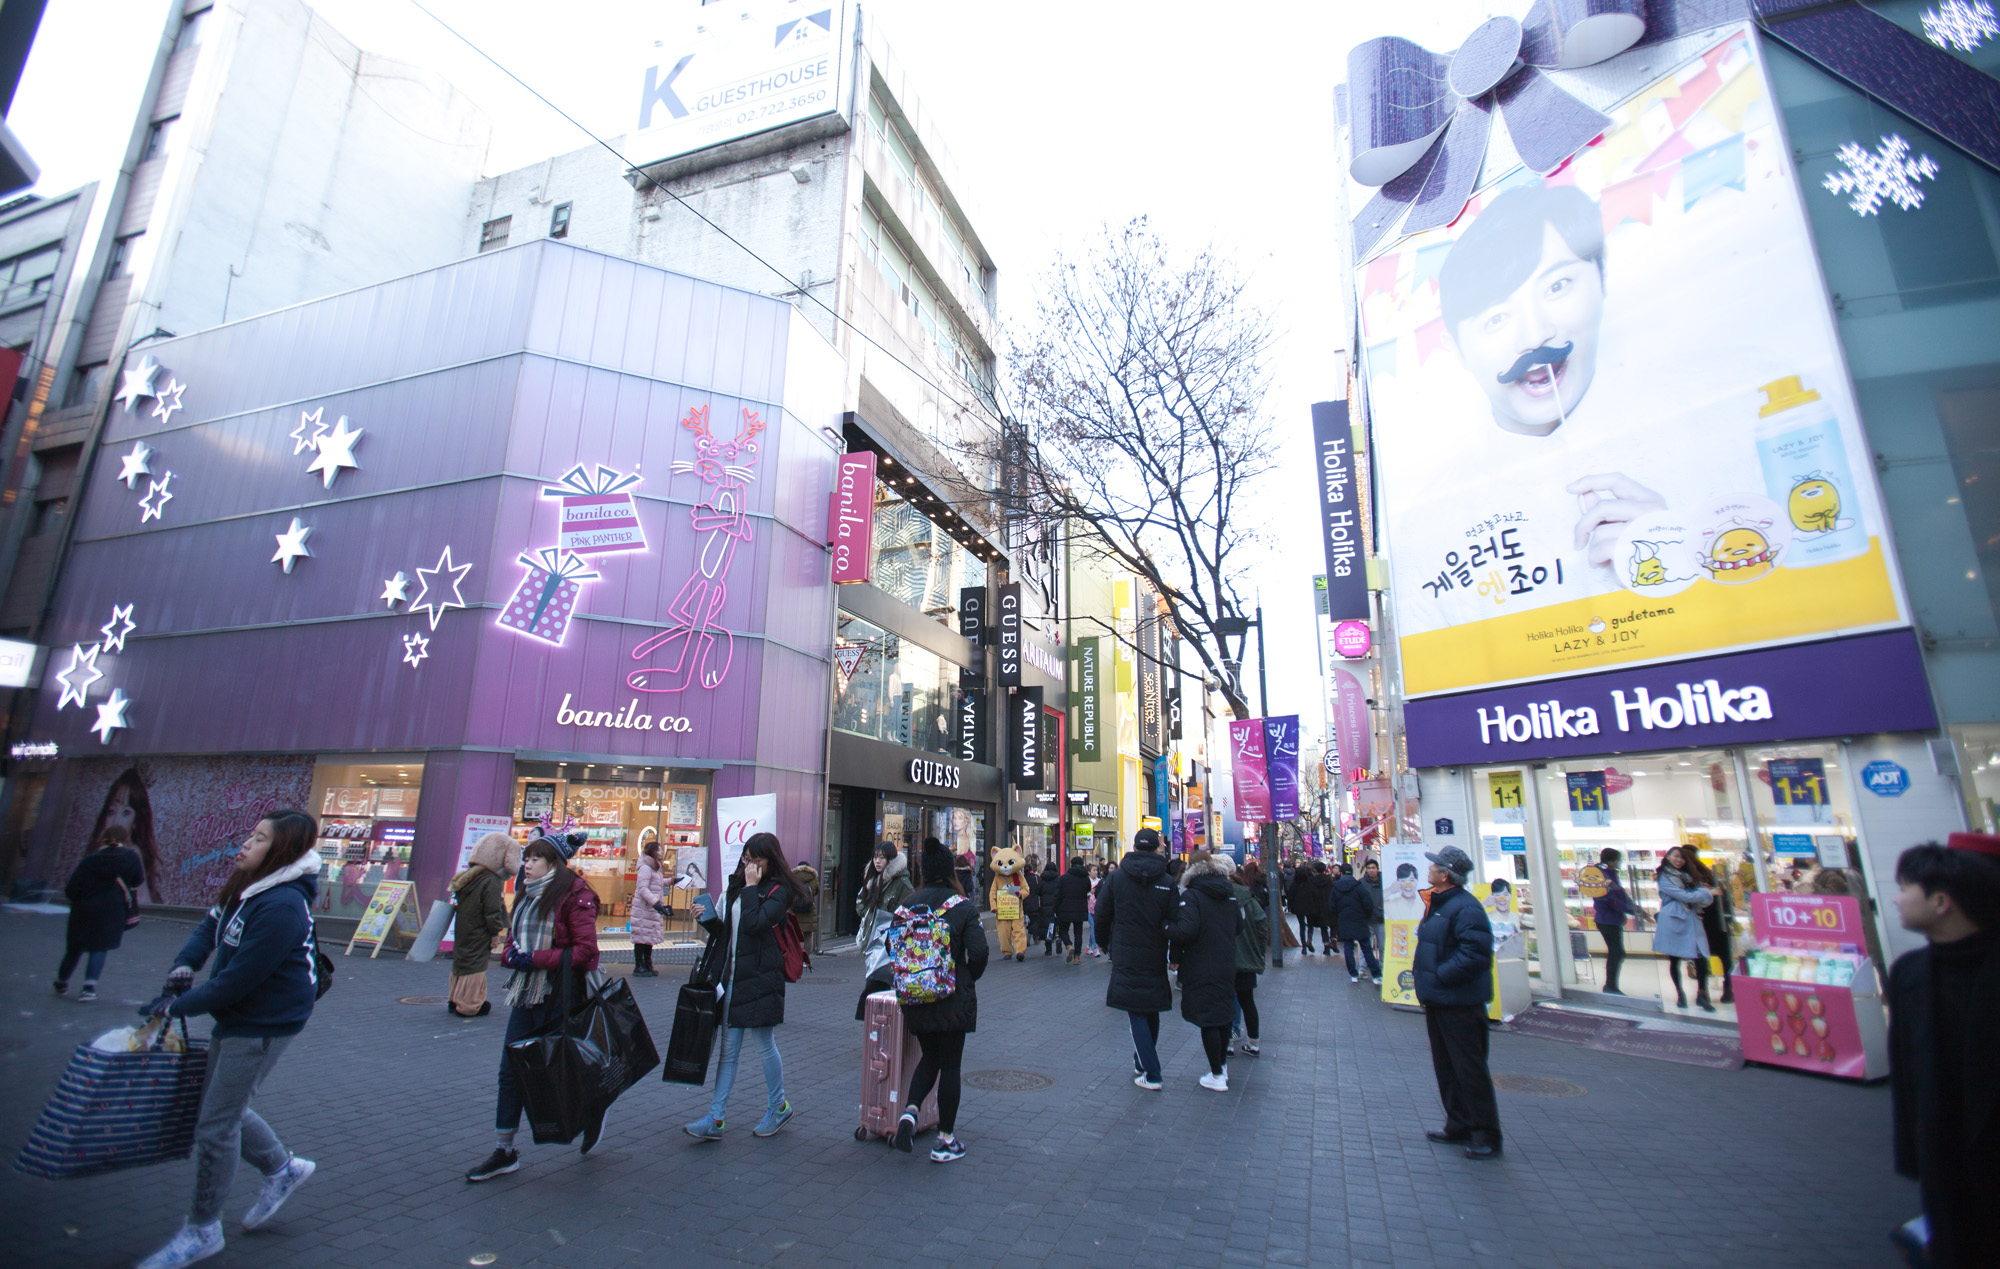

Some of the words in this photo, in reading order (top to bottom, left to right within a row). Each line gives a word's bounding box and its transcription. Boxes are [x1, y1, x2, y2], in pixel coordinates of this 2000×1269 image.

[737, 90, 826, 124] 02.722.3650
[1322, 438, 1349, 503] Holika
[566, 506, 611, 520] banila
[614, 508, 631, 517] co.
[838, 462, 867, 542] banila
[592, 532, 633, 545] PANTHER
[1329, 509, 1356, 577] Holika
[835, 547, 850, 575] co.
[1422, 528, 1525, 598] 게을러도
[1002, 595, 1017, 674] GUESS
[1526, 630, 1554, 642] Holika
[1556, 625, 1584, 637] Holika
[1611, 606, 1675, 629] gudetama
[837, 649, 861, 658] GUESS
[1339, 637, 1366, 645] ETUDE
[1554, 638, 1590, 653] LAZY
[1596, 636, 1605, 645] &
[1611, 629, 1639, 643] JOY
[1022, 638, 1064, 681] ARITAUM
[1083, 647, 1095, 698] NATURE
[557, 694, 652, 730] banila
[659, 715, 693, 732] co.
[1084, 701, 1095, 751] REPUBLIC
[1346, 693, 1357, 729] Princess
[1477, 700, 1599, 744] Holika
[1611, 679, 1774, 732] Holika
[1023, 700, 1036, 777] ARITAUM
[1351, 731, 1360, 758] House
[911, 758, 960, 789] GUESS
[1871, 771, 1900, 786] ADT
[1494, 786, 1521, 808] 1+1
[1571, 786, 1604, 811] 1+1
[1776, 776, 1822, 805] 1+1
[1082, 803, 1099, 817] NATURE
[1100, 804, 1118, 818] REPUBLIC
[725, 819, 756, 845] CC
[1440, 826, 1449, 834] 37
[1613, 1039, 1664, 1052] Holika
[1668, 1044, 1722, 1057] Holika
